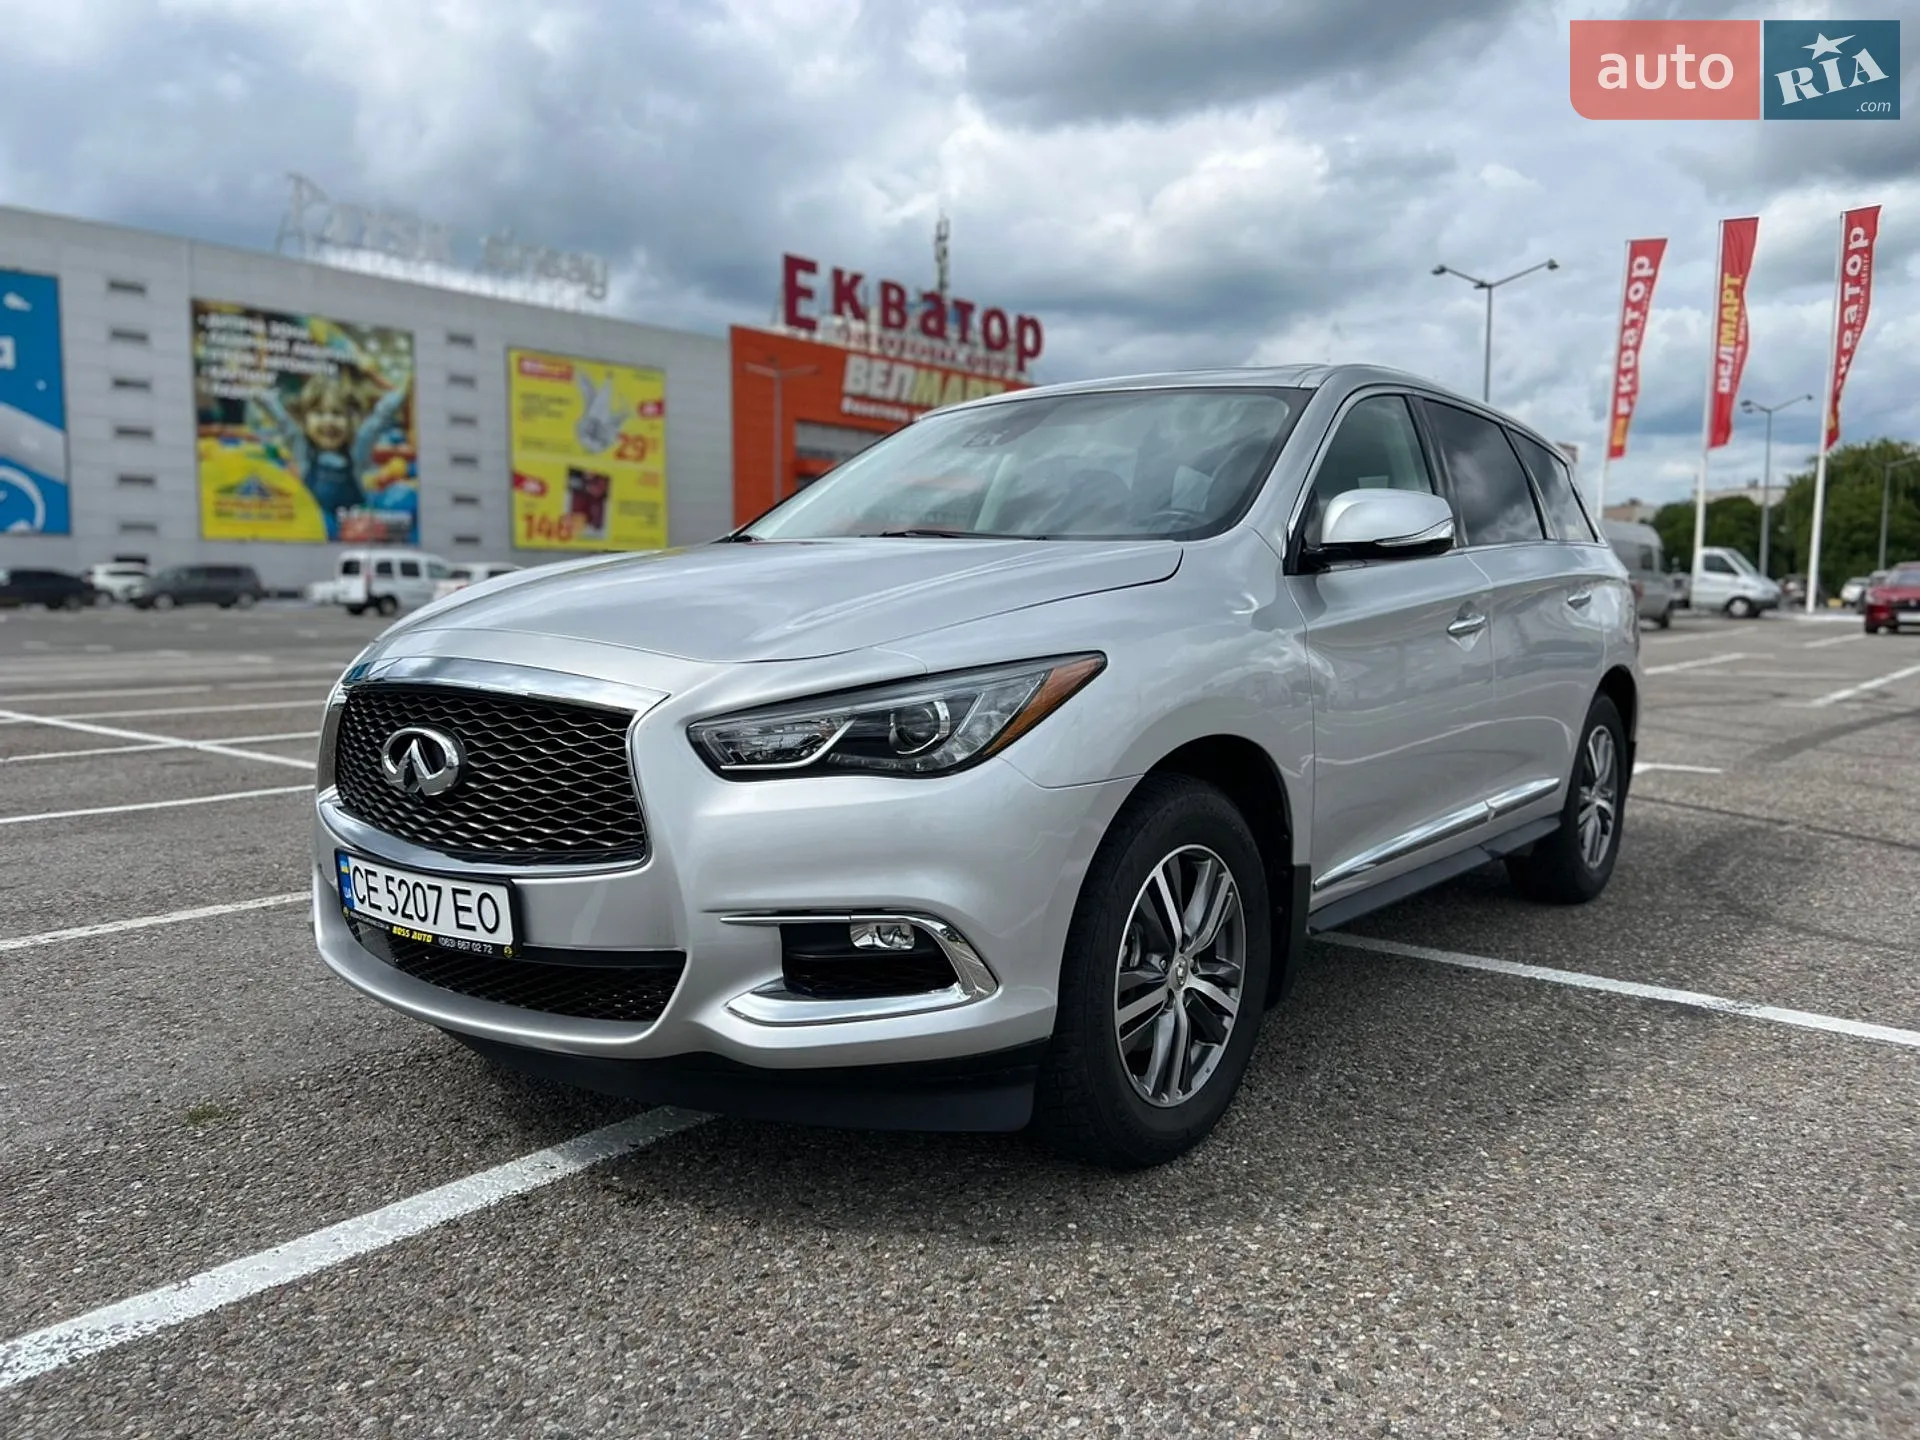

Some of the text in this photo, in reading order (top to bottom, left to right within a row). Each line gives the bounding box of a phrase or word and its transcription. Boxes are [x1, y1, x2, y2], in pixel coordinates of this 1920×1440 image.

[352, 865, 500, 934] CE 5207 EO
[482, 943, 493, 954] 72
